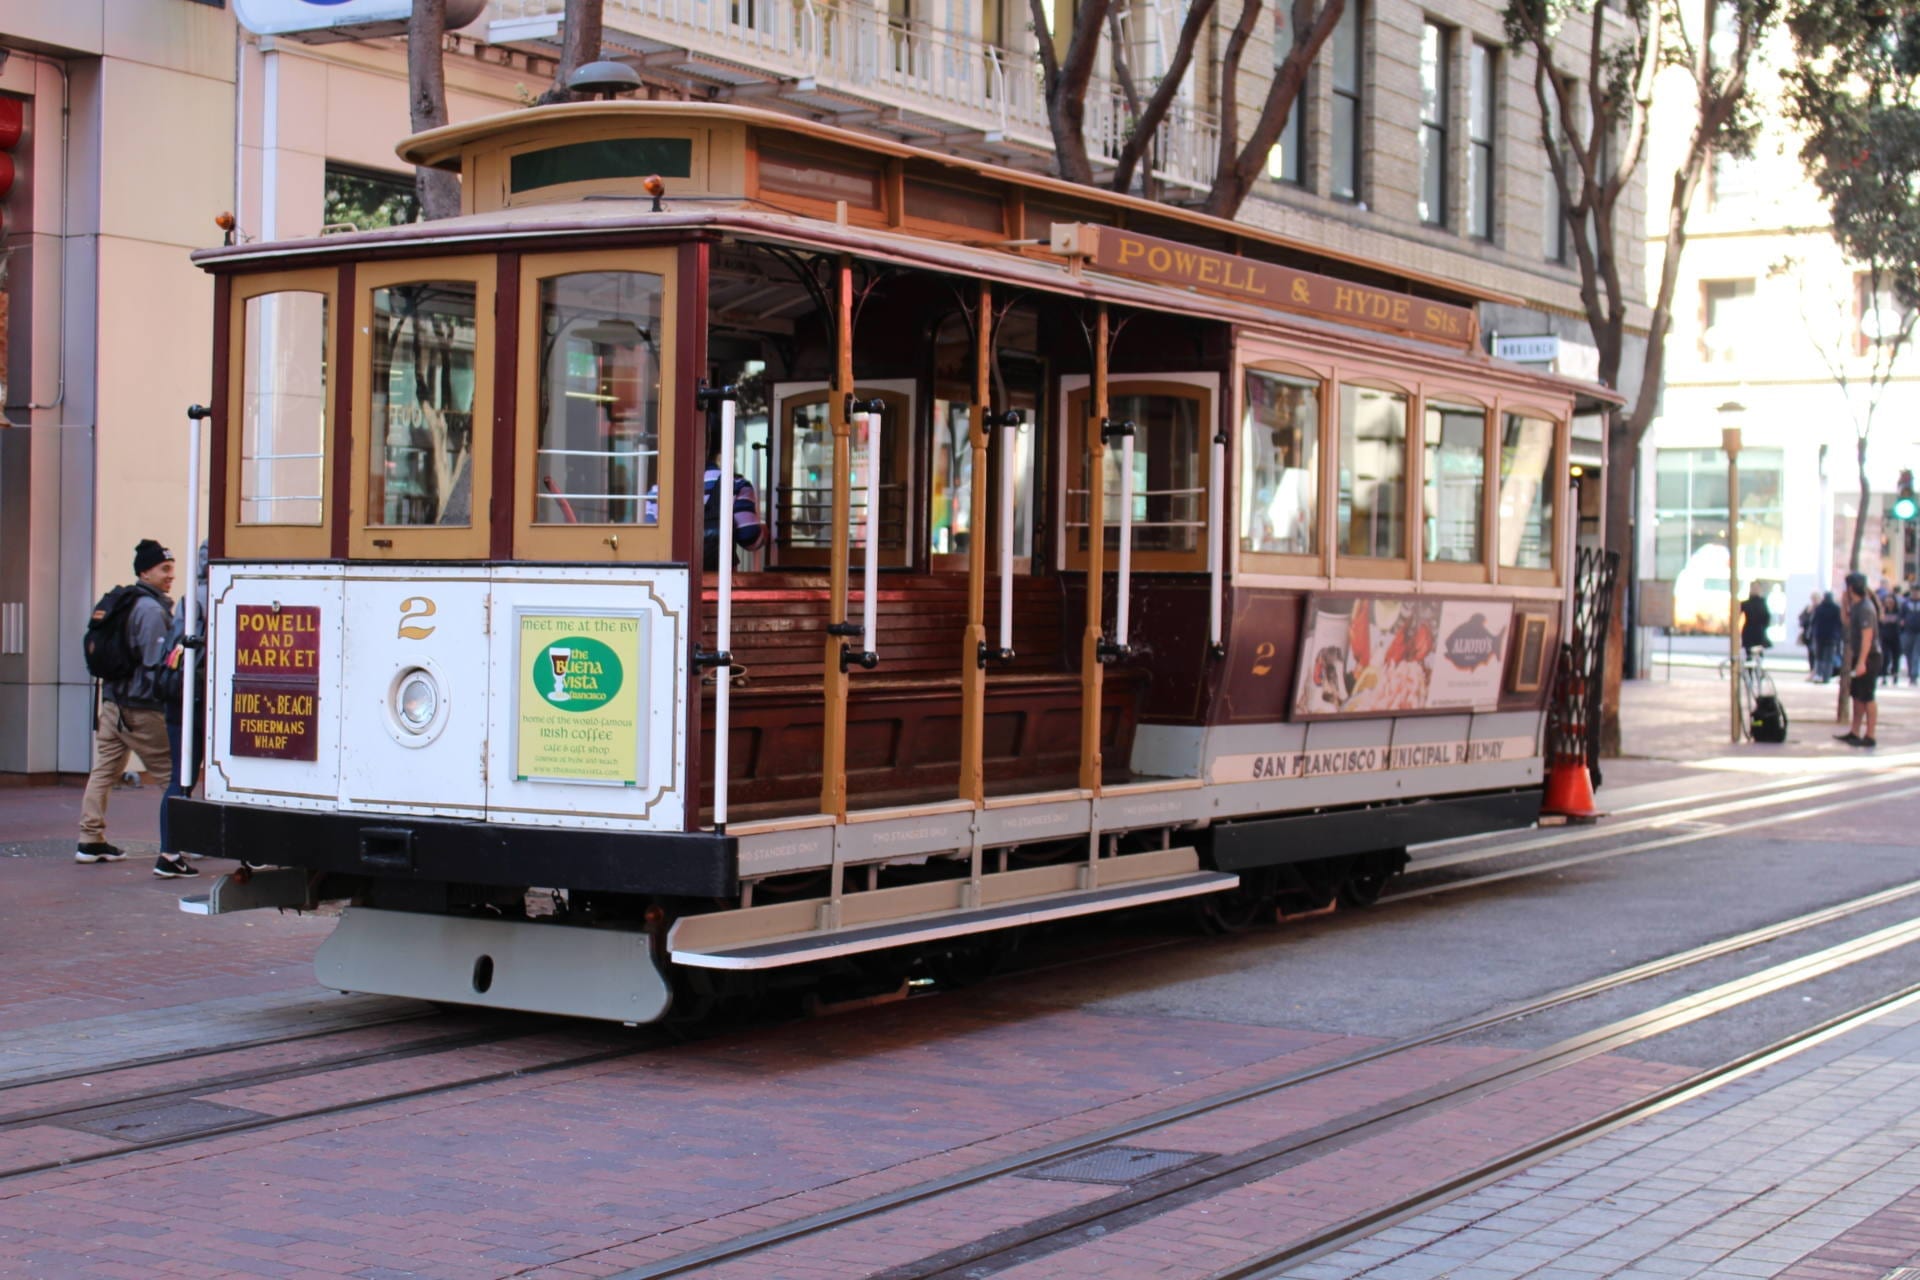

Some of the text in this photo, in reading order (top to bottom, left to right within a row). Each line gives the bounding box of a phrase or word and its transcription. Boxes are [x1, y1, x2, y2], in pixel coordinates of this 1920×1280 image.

[1118, 238, 1461, 335] POWELL & HYDE Sts.
[239, 613, 316, 632] POWELL
[397, 596, 436, 641] 2
[556, 620, 574, 631] me
[595, 619, 616, 632] the
[259, 633, 294, 648] AND
[237, 648, 316, 667] MARKET
[571, 648, 589, 660] the
[1251, 642, 1276, 676] 2
[234, 693, 261, 713] HYDE
[277, 695, 313, 716] BEACH
[240, 718, 305, 735] FISHERMANS
[571, 727, 613, 742] coffee
[254, 735, 288, 750] WHARF
[1253, 756, 1286, 778] SAN
[1292, 748, 1376, 775] FRANCISCO
